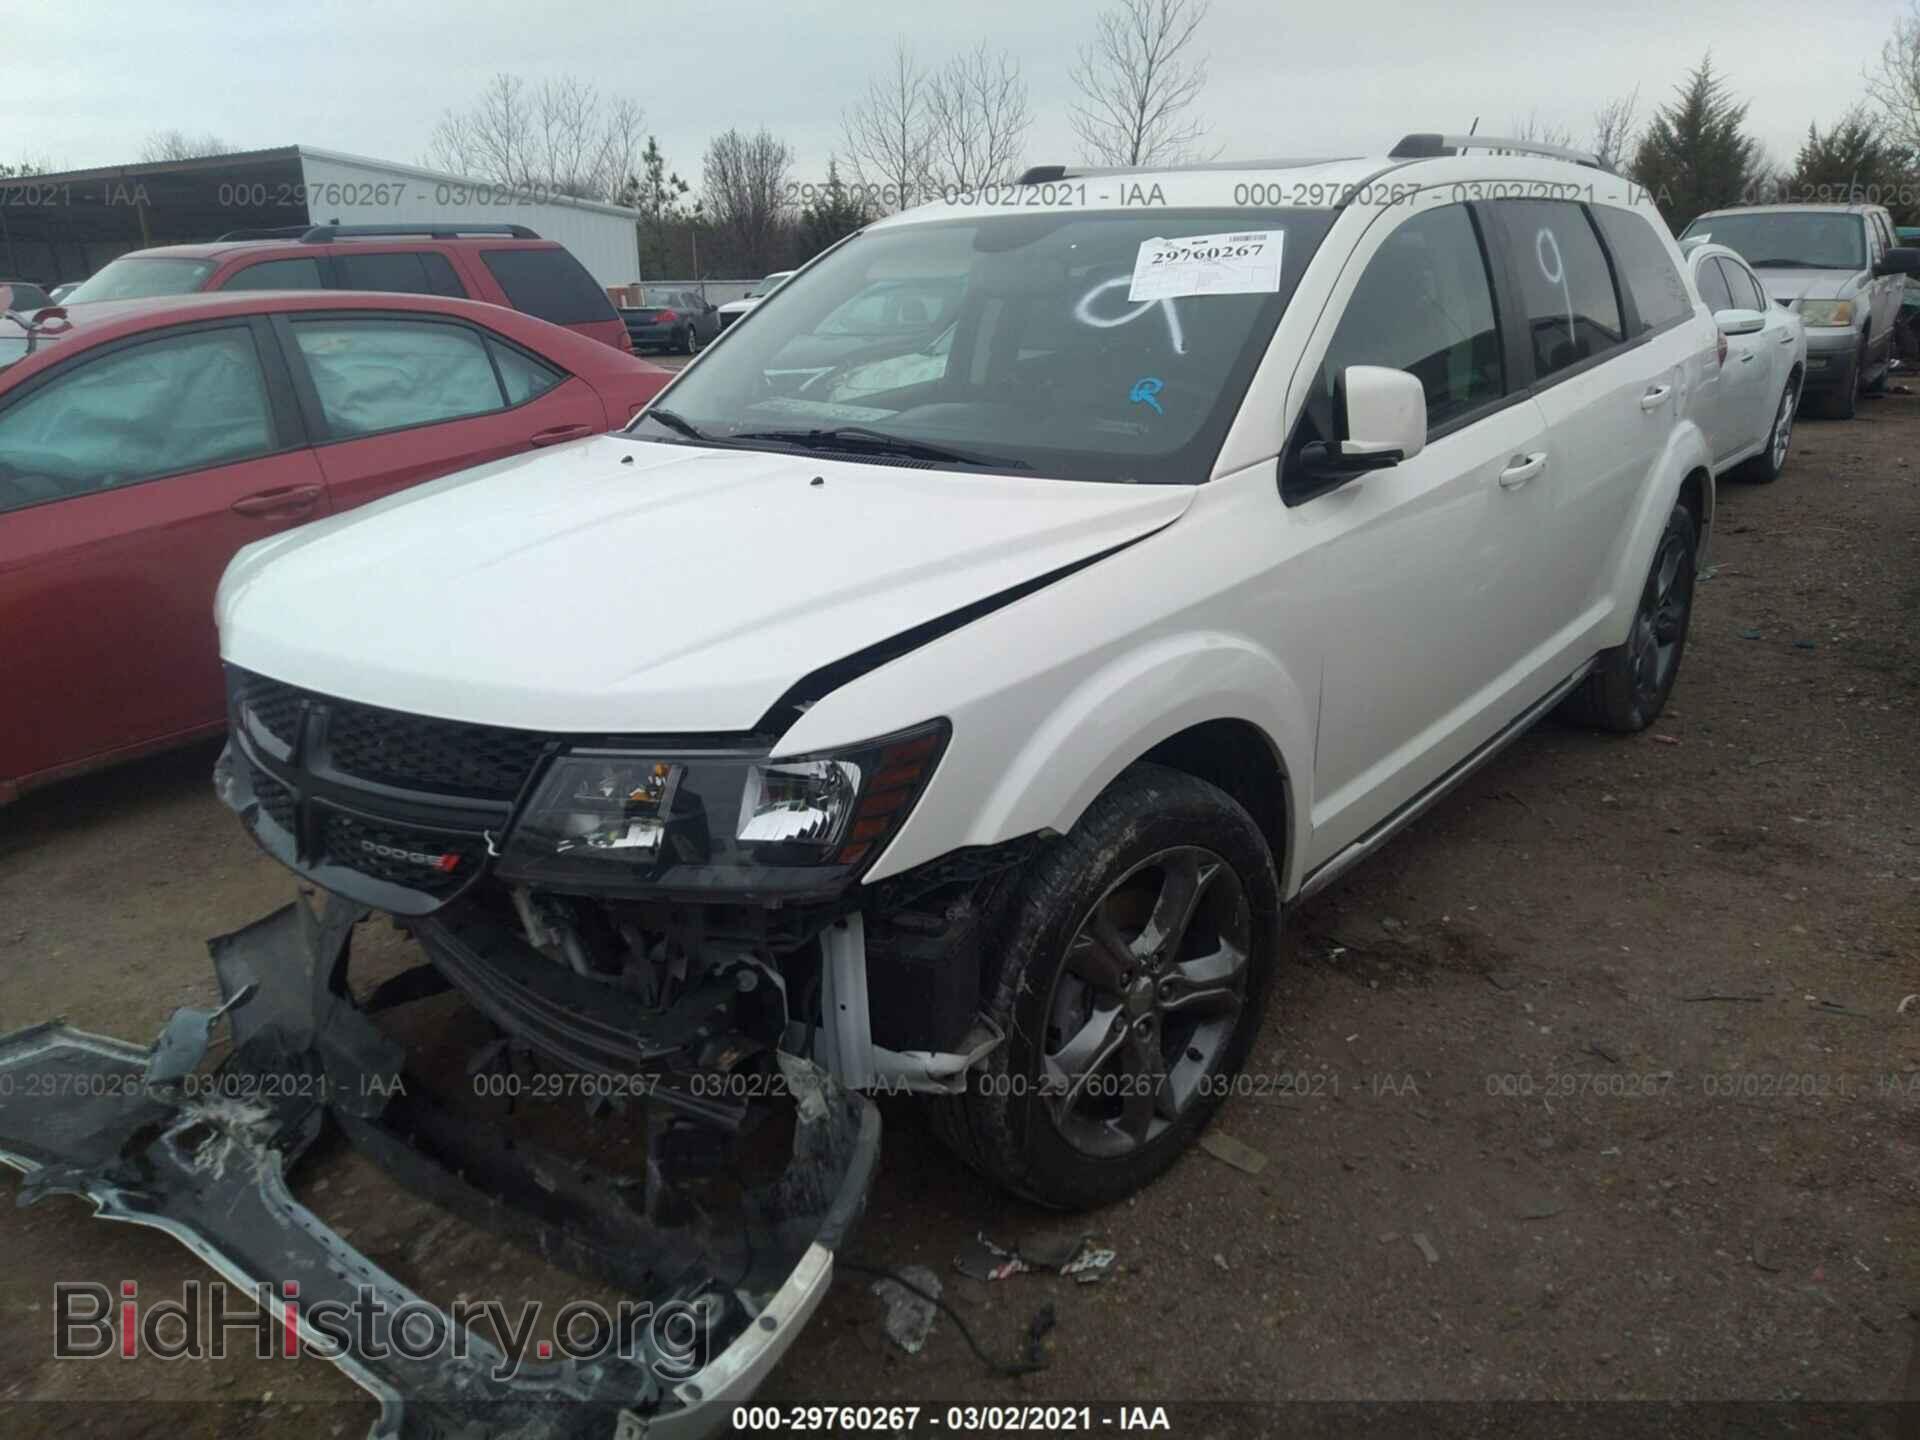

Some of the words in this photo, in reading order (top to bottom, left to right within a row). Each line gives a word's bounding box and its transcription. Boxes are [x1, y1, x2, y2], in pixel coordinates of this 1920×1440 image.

[1151, 244, 1264, 264] 29760267
[1535, 227, 1576, 344] 9
[360, 840, 444, 866] DODGE
